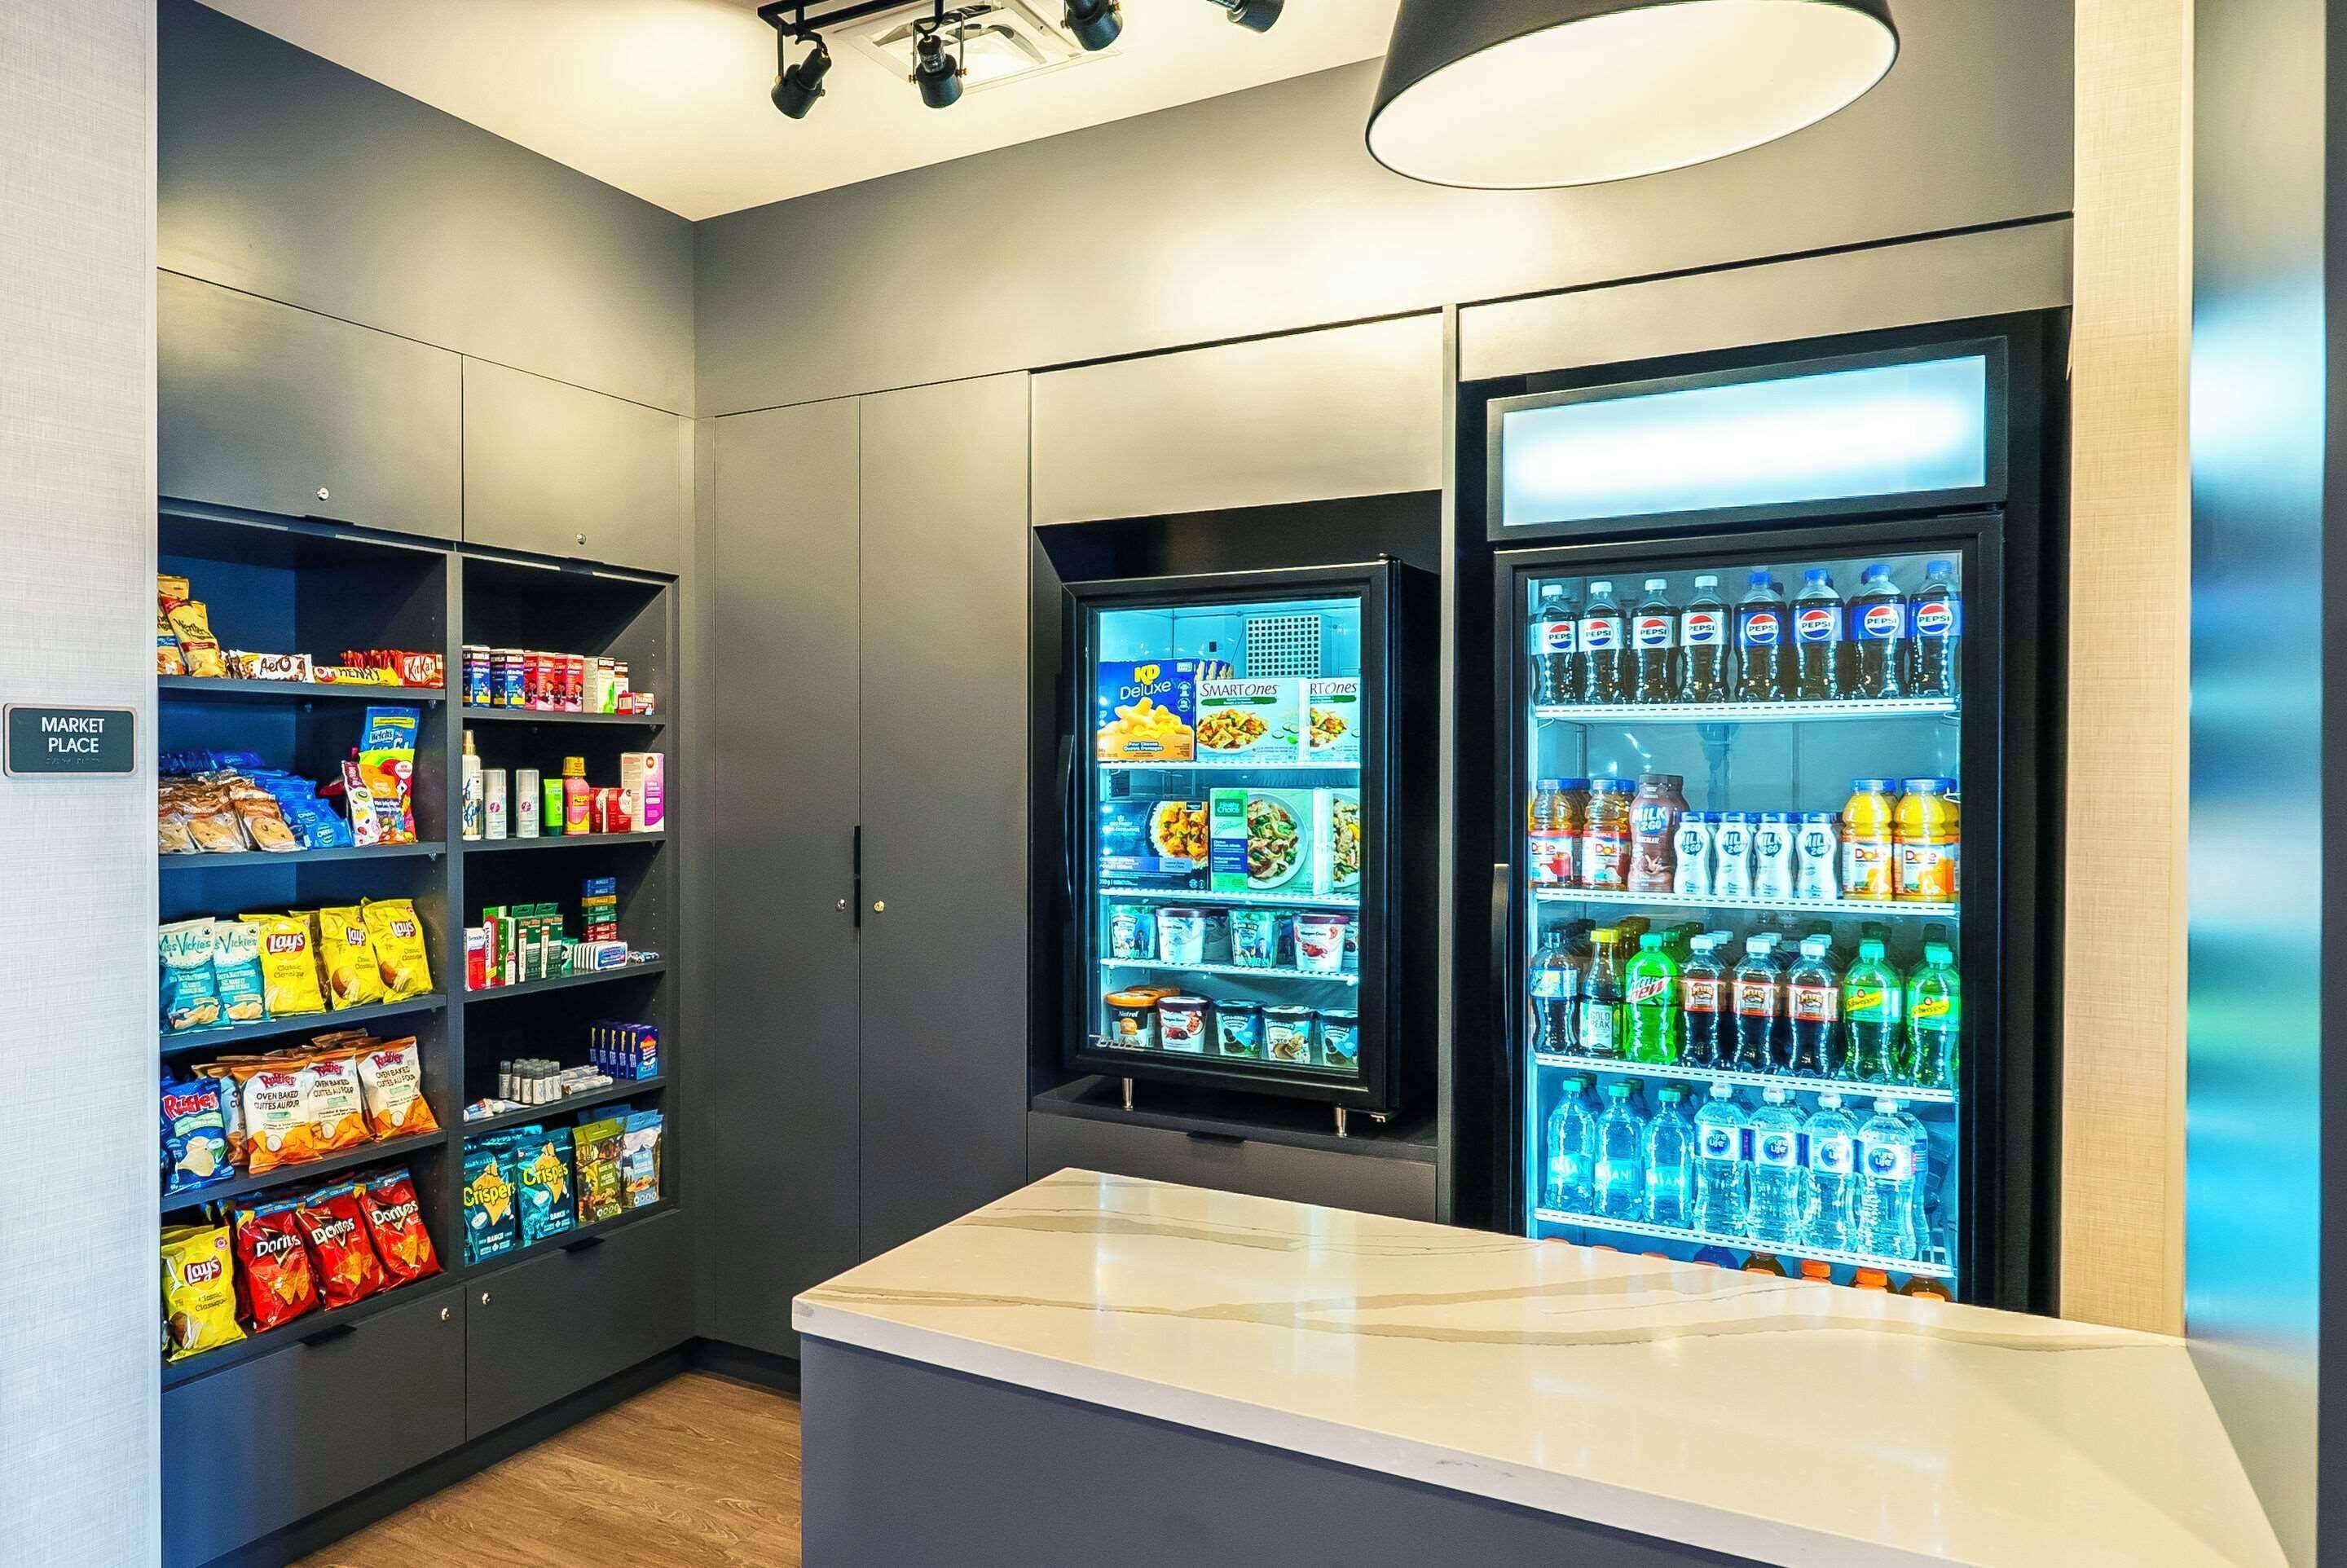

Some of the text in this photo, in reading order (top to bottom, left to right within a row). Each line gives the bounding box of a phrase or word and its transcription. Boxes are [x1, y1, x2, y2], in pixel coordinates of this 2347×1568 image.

[1134, 664, 1160, 685] KD
[1120, 681, 1172, 700] Deluxe
[42, 716, 105, 733] MARKET
[48, 737, 99, 753] PLACE
[1632, 805, 1667, 823] MILK
[1640, 820, 1662, 831] 2GO
[1684, 843, 1702, 853] 2GO
[1905, 849, 1937, 861] Doe
[1590, 1011, 1610, 1020] GOLD
[1590, 1020, 1610, 1028] PEAK
[258, 1072, 297, 1088] Ruffles
[376, 1070, 390, 1078] OVEN
[256, 1090, 299, 1100] OVEN BAKED
[254, 1102, 276, 1110] CUITES
[277, 1101, 285, 1109] AU
[523, 1162, 569, 1186] Crispers
[464, 1182, 516, 1207] Crispers
[372, 1200, 419, 1225] Doritos
